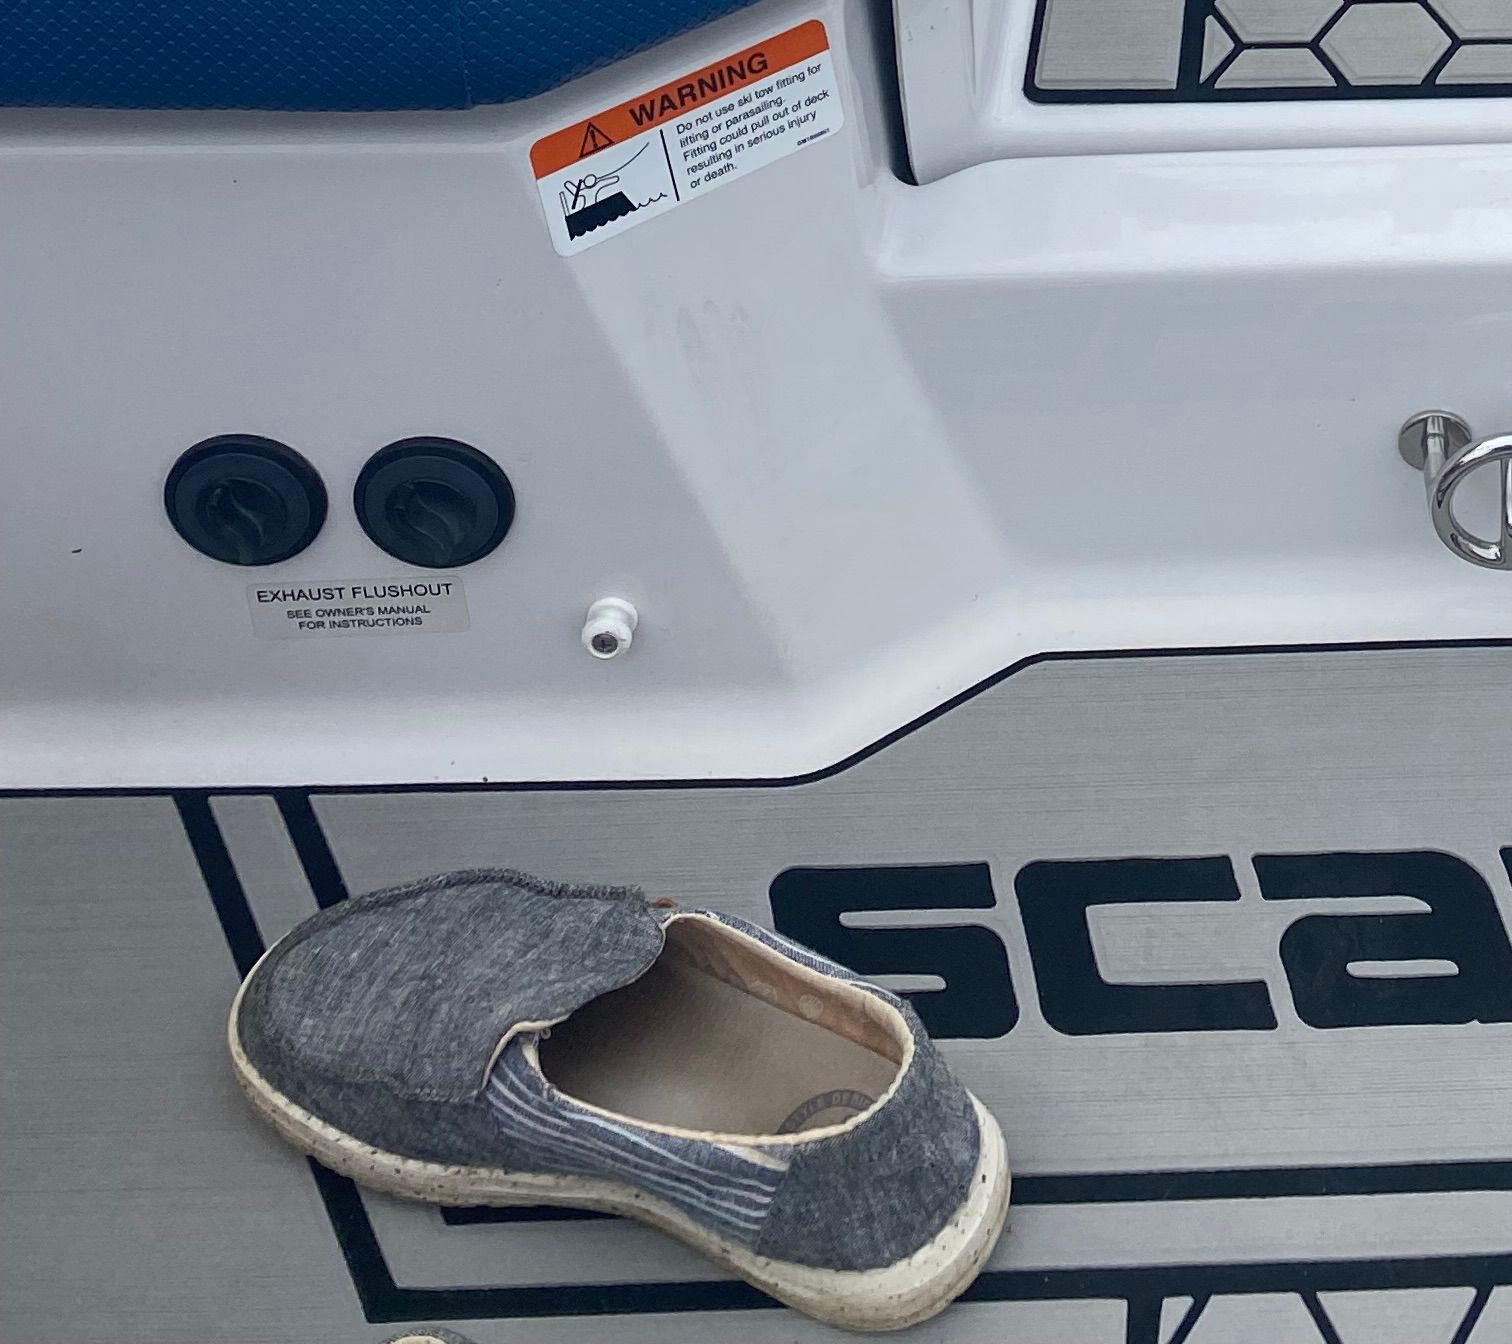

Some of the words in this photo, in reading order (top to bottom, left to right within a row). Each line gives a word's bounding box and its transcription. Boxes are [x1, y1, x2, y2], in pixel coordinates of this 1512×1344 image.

[630, 51, 769, 127] WARNING
[676, 123, 693, 135] Do
[695, 112, 714, 127] not
[715, 103, 735, 117] use
[737, 93, 753, 107] ski
[754, 85, 774, 99] tow
[775, 71, 806, 90] fitting
[807, 63, 822, 76] for
[679, 129, 709, 148] lifting
[711, 122, 722, 134] or
[683, 141, 718, 162] Fitting
[719, 125, 749, 145] could
[751, 115, 770, 133] pull
[772, 106, 790, 122] out
[791, 100, 802, 113] of
[804, 89, 830, 107] deck
[686, 148, 733, 175] resulting
[734, 142, 745, 153] in
[747, 124, 786, 148] serious
[787, 110, 817, 129] injury
[690, 178, 702, 189] or
[256, 587, 345, 603] EXHAUST
[351, 583, 453, 599] FLUSHOUT
[286, 609, 312, 619] SEE
[315, 606, 375, 618] OWNER'S
[377, 604, 431, 616] MANUAL
[298, 620, 325, 630] FOR
[328, 616, 423, 629] INSTRUCTIONS
